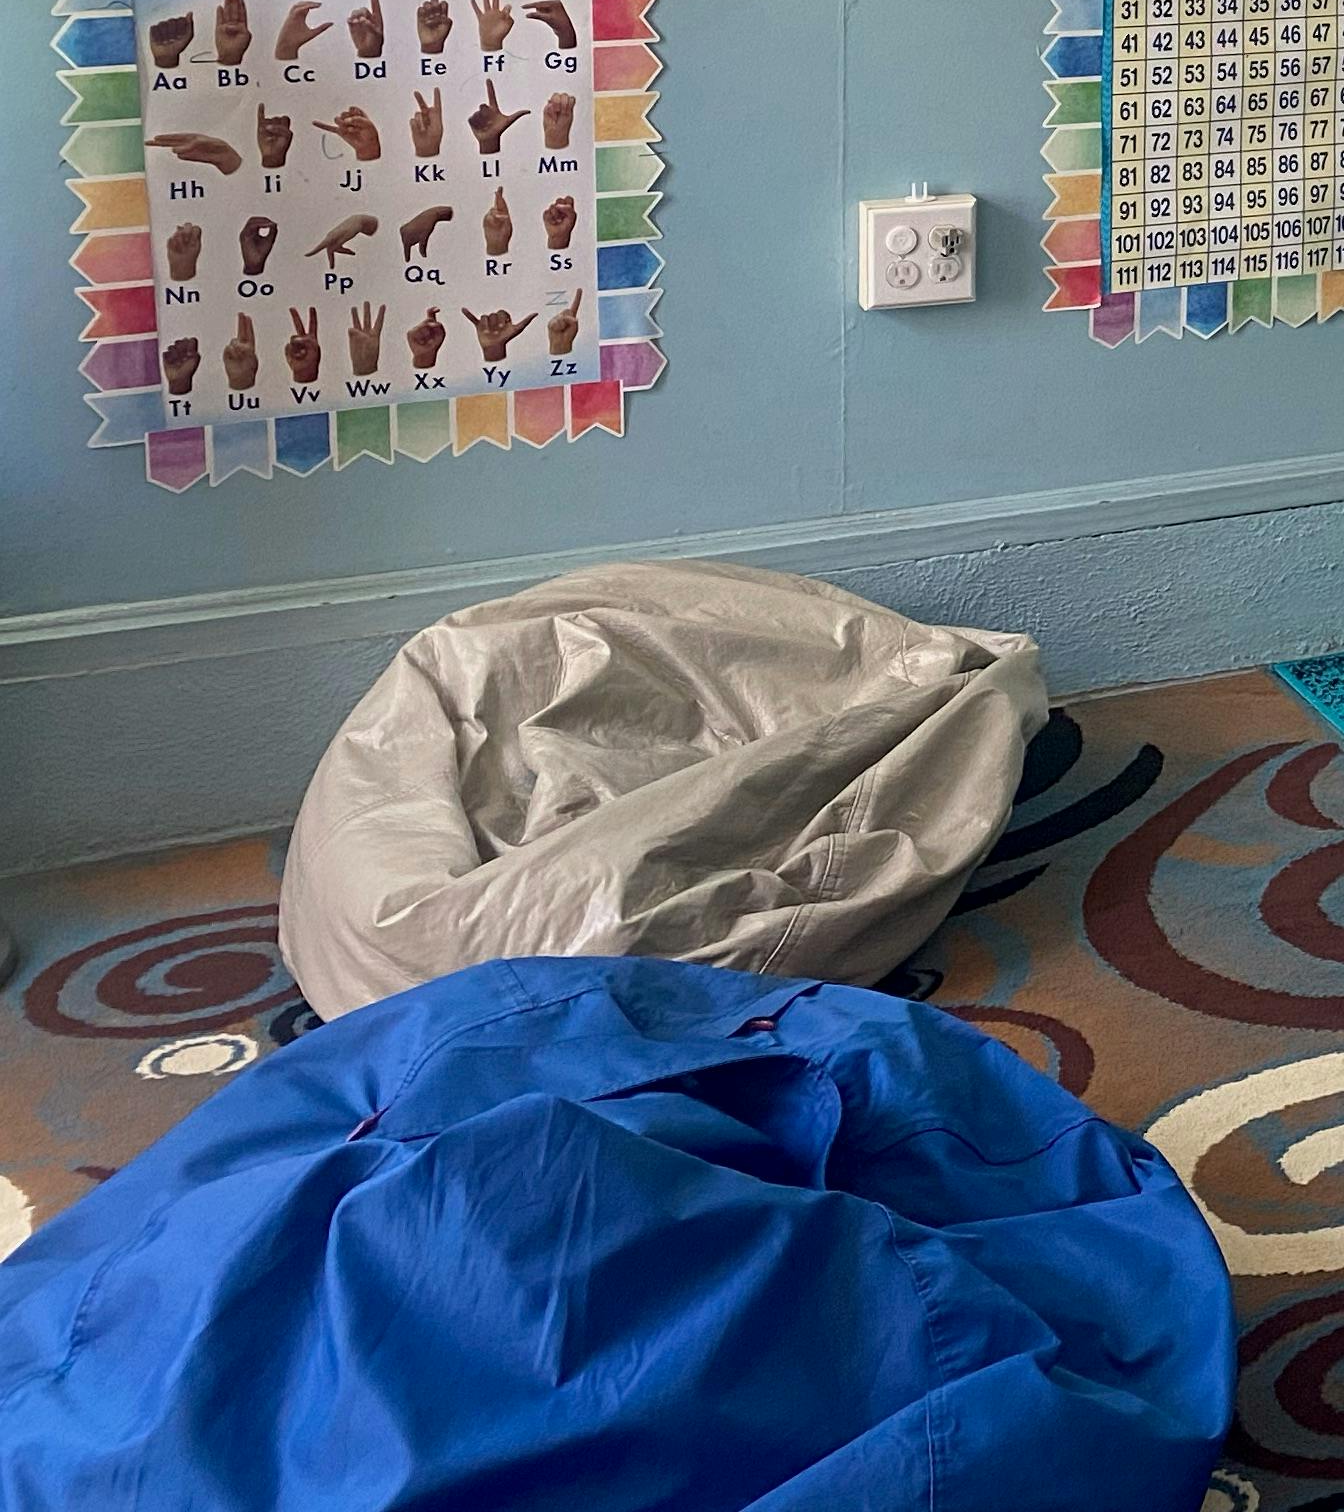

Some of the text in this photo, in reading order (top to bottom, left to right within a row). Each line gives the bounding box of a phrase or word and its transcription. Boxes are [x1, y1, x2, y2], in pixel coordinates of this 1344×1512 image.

[1217, 28, 1238, 48] 44
[544, 52, 578, 74] Gg
[152, 71, 188, 91] Aa
[1310, 87, 1329, 107] 67
[538, 156, 579, 175] Mm
[1119, 165, 1138, 186] 81
[170, 182, 204, 200] Hh
[404, 265, 445, 286] Qq
[346, 379, 391, 399] Ww
